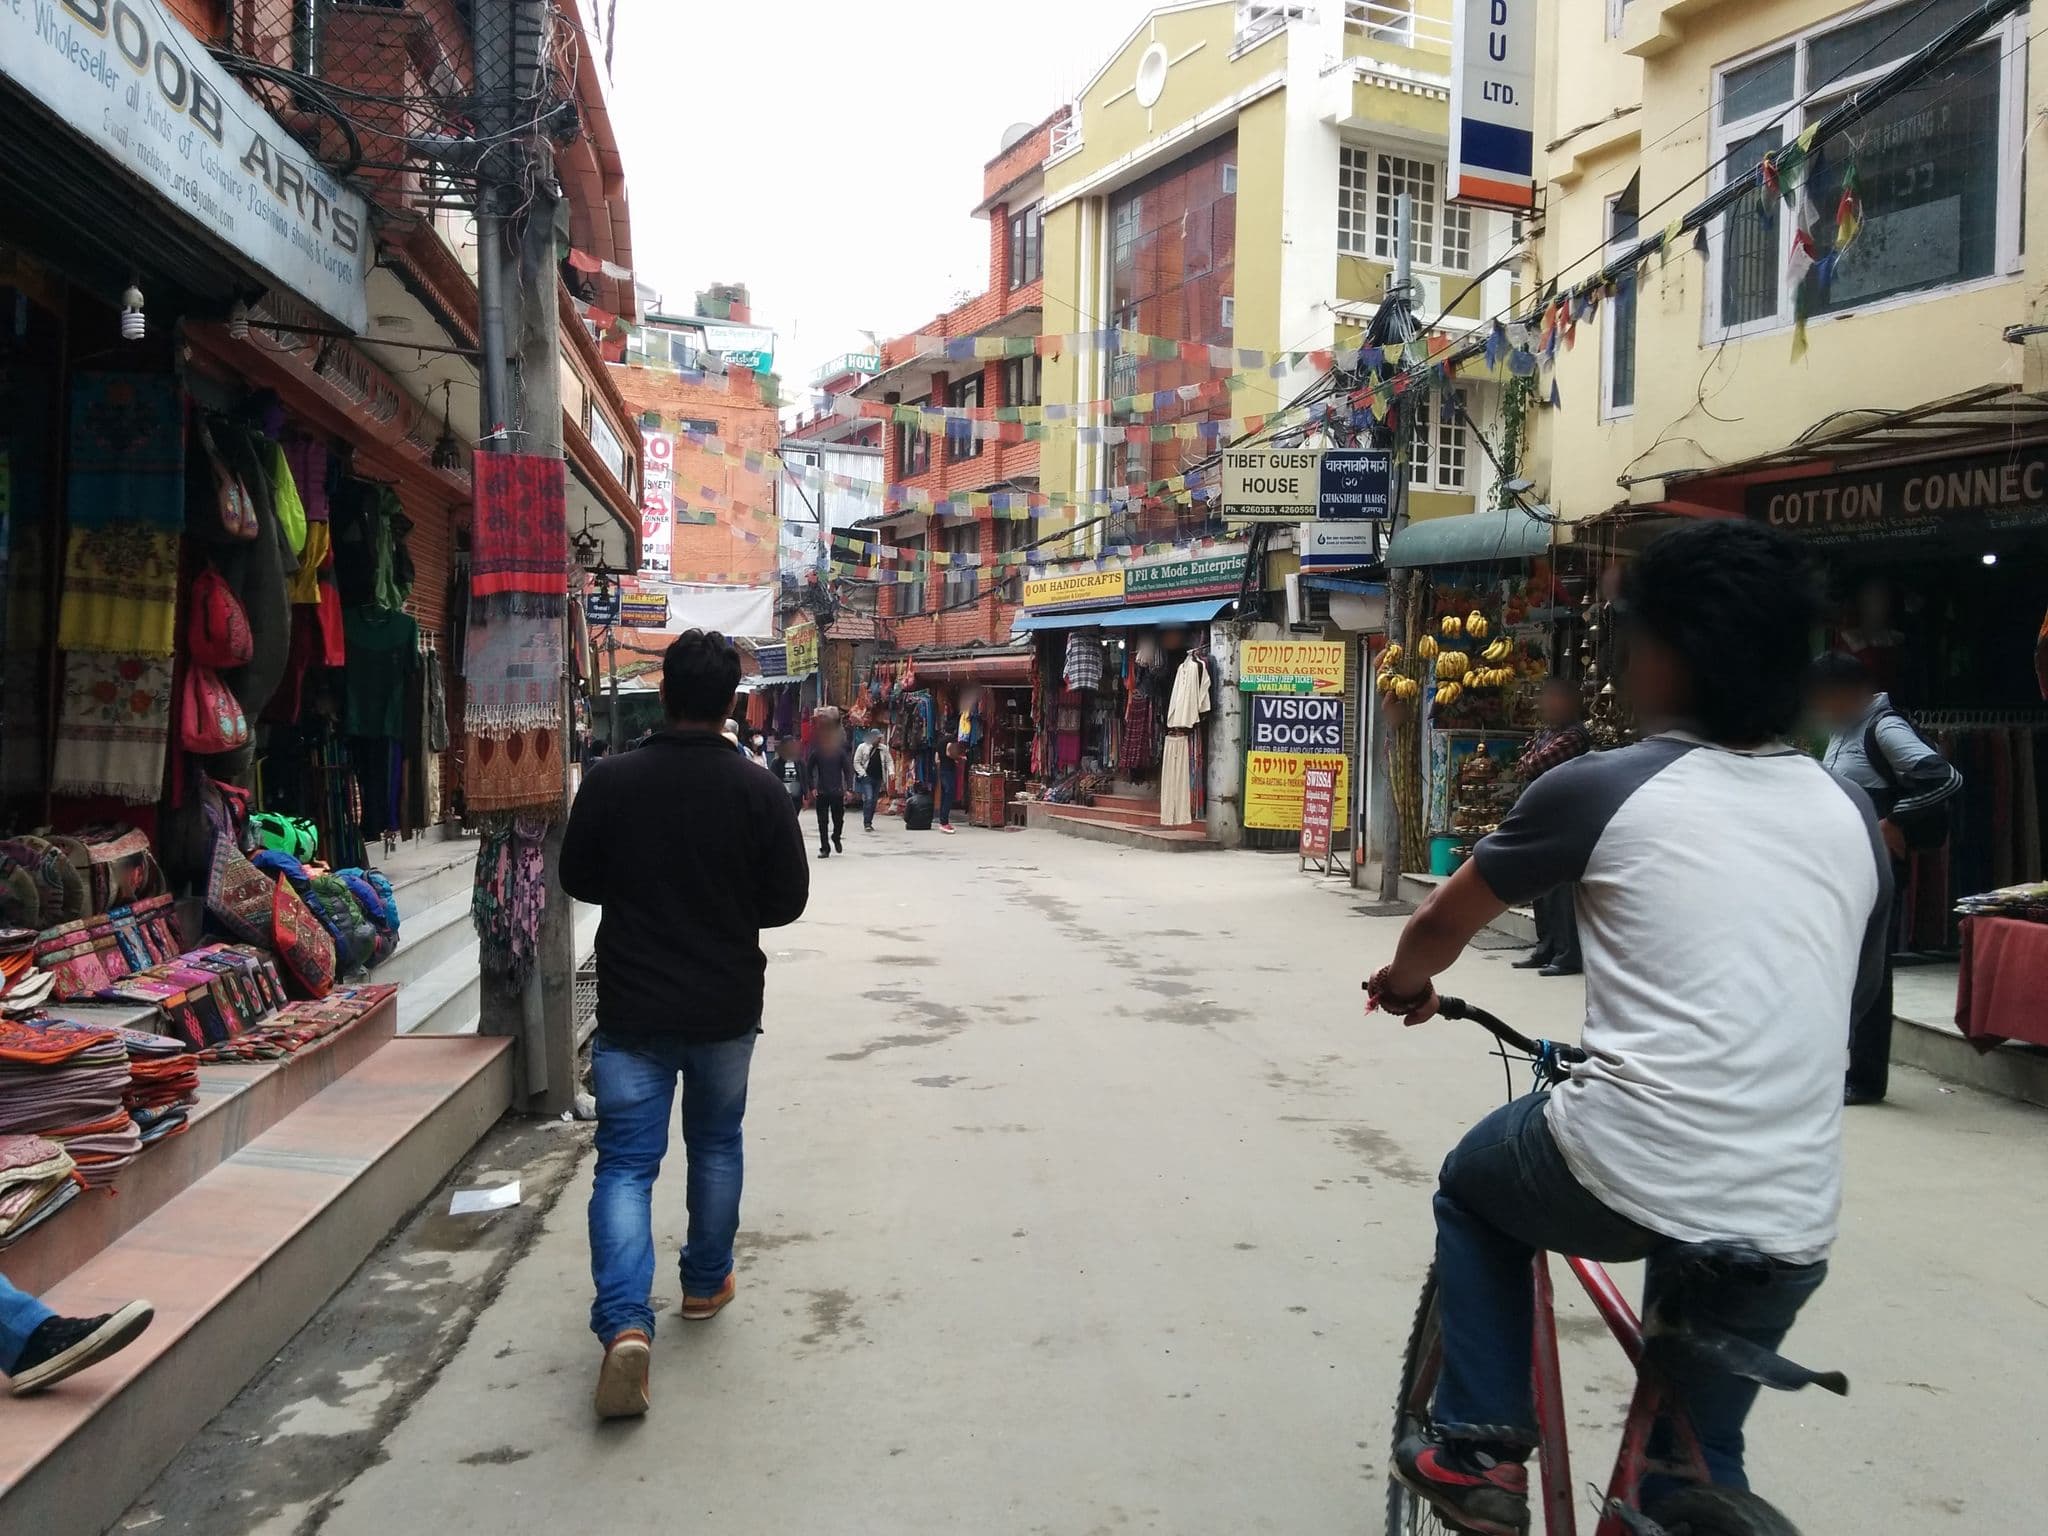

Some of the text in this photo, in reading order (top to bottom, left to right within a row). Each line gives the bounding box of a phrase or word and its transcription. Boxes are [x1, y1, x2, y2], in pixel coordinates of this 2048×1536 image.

[1483, 80, 1519, 106] LTD.
[126, 80, 140, 112] all
[178, 131, 194, 160] of
[239, 134, 360, 258] ARTS
[847, 354, 879, 370] HOLY
[1226, 454, 1317, 469] TIBET GUEST
[1242, 478, 1299, 493] HOUSE
[1768, 482, 1883, 525] COTTON
[1903, 461, 2048, 513] CONNEC
[1364, 493, 1387, 504] MARG
[1240, 506, 1277, 515] 4260383,
[1279, 506, 1315, 514] 4260556
[1135, 570, 1147, 581] Fil
[1150, 567, 1159, 579] &
[1161, 564, 1188, 578] Mode
[1032, 583, 1047, 593] OM
[1049, 572, 1122, 591] HANDICRAFTS
[1247, 666, 1340, 675] SWISSA AGENCY
[1261, 699, 1338, 720] VISION
[1257, 723, 1340, 745] BOOKS
[1306, 771, 1332, 788] SWISSA
